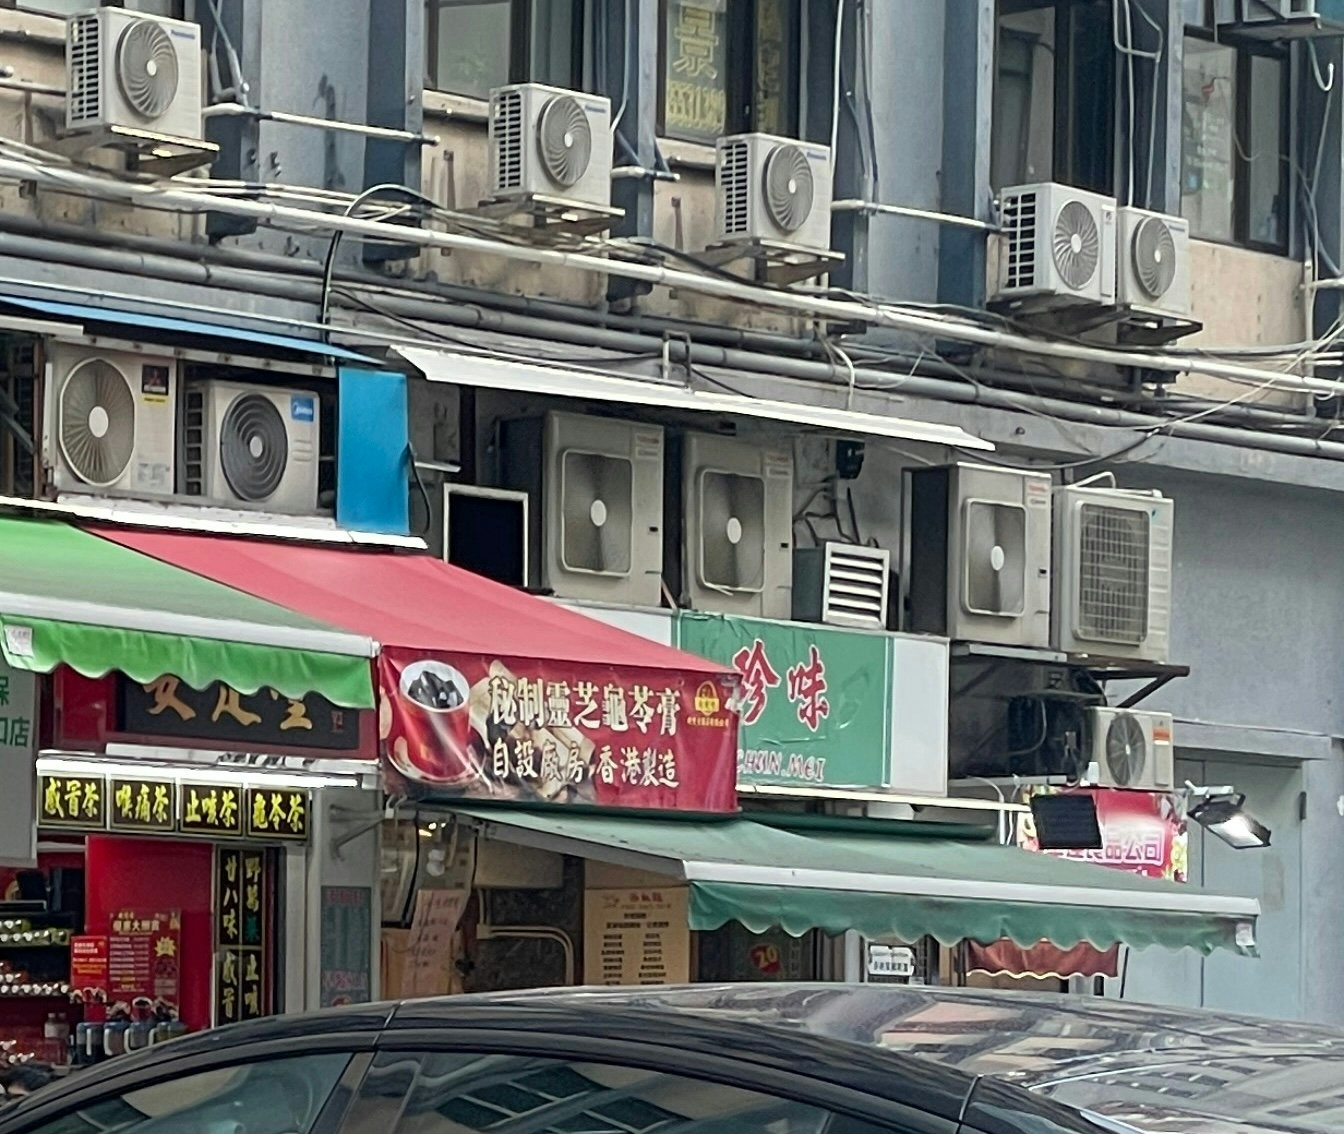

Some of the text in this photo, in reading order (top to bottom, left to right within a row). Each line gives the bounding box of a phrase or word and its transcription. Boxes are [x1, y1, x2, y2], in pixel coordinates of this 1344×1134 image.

[488, 676, 682, 737] 秘制靈芝龜苓膏
